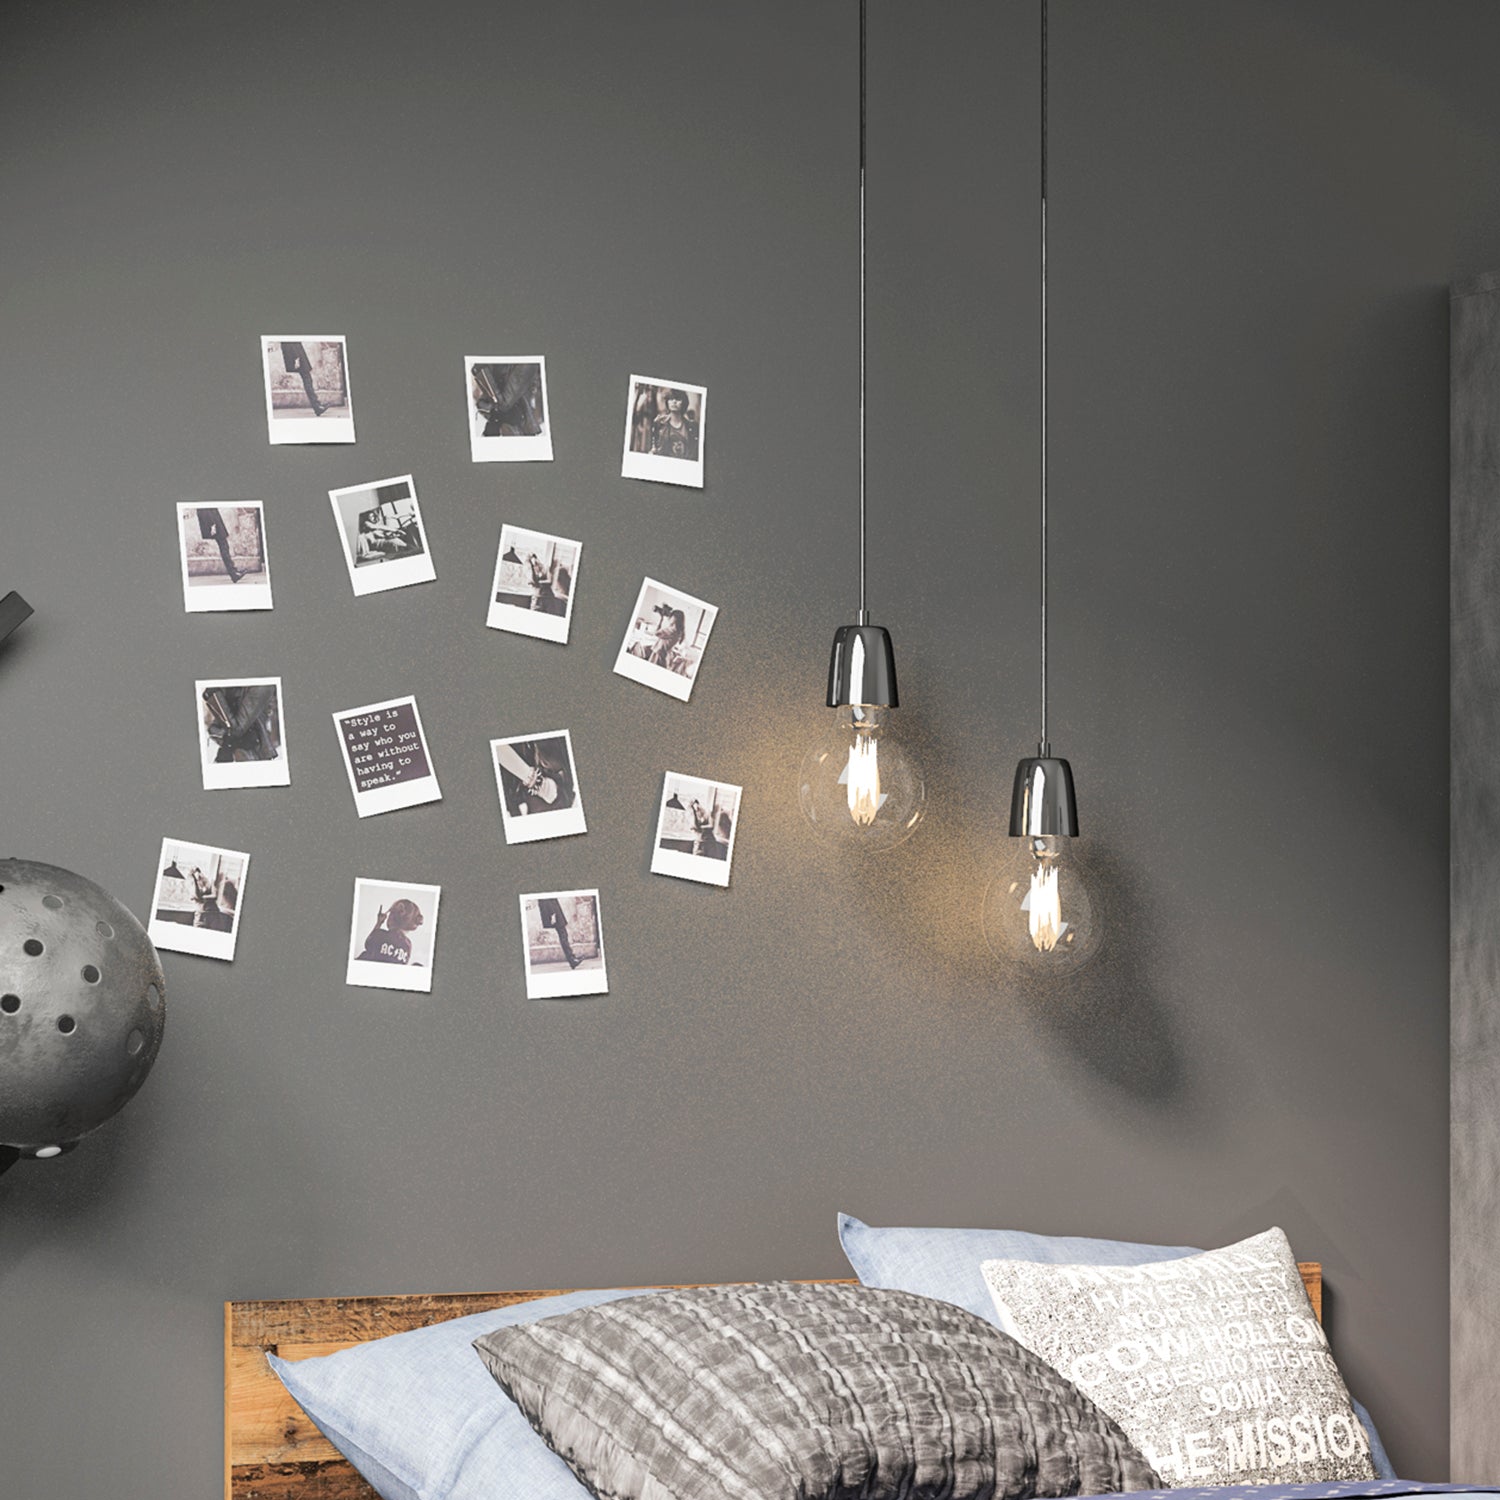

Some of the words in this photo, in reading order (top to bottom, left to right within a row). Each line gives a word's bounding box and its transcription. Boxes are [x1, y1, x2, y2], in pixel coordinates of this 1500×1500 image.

[359, 727, 378, 737] way
[383, 724, 396, 732] to
[386, 710, 399, 719] is
[351, 742, 370, 752] say
[374, 737, 393, 747] who
[398, 731, 416, 743] you
[354, 754, 373, 764] are
[377, 743, 420, 758] without
[356, 761, 394, 776] having
[398, 757, 412, 766] to
[1089, 1283, 1198, 1312] HAYES
[1197, 1272, 1290, 1299] VALLEY
[1118, 1303, 1216, 1332] NORTH
[1218, 1294, 1293, 1320] BEACH
[1070, 1331, 1188, 1385] COW
[1124, 1353, 1249, 1401] PRESIDIO
[1249, 1347, 1339, 1373] HEIGHTS
[1200, 1377, 1287, 1417] SOMA
[1140, 1430, 1220, 1480] HE
